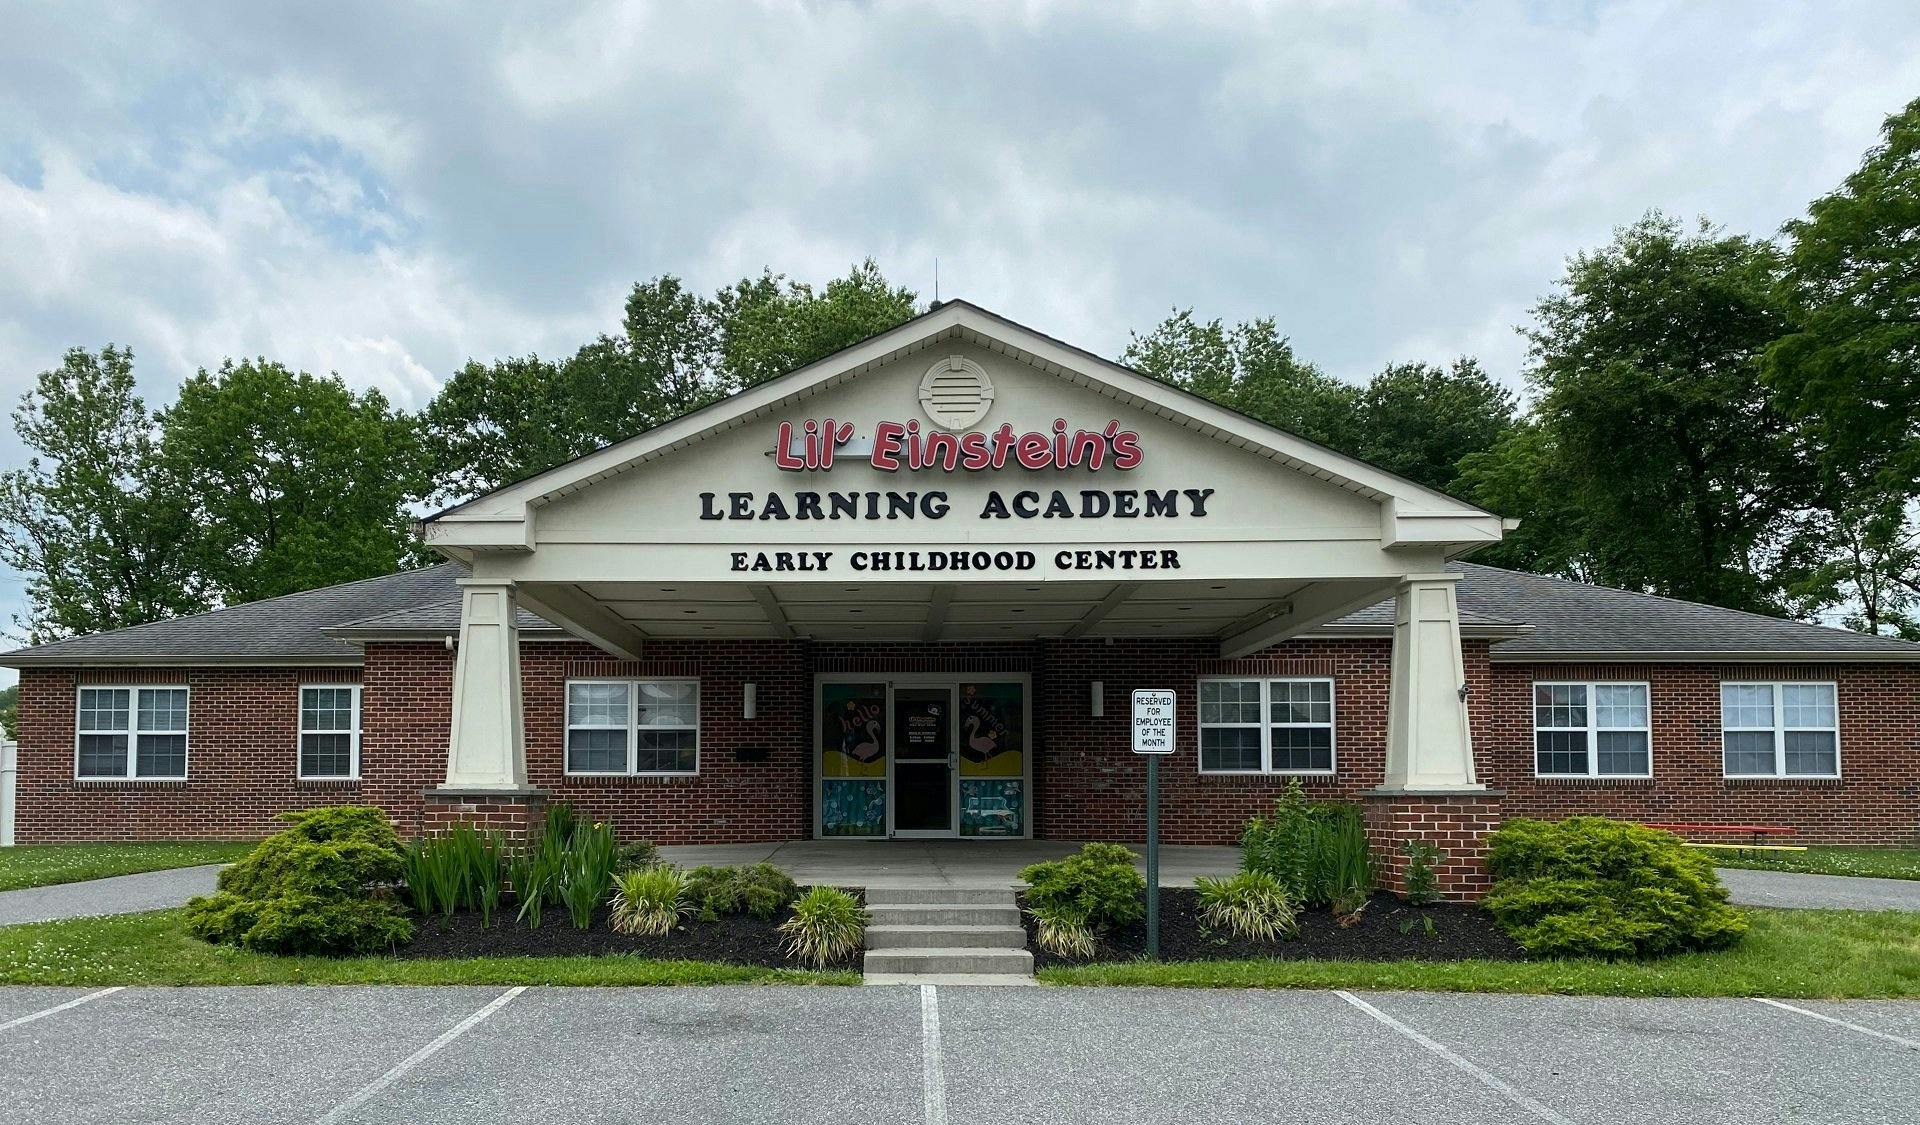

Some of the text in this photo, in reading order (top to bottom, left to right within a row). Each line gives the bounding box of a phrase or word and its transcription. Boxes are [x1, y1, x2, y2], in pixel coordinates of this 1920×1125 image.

[870, 418, 1144, 471] Einstein's
[699, 488, 1215, 520] LEARNING ACADEMY
[730, 550, 1181, 571] EARLY CHILDHOOD CENTER
[1136, 697, 1171, 705] RESERVED
[1146, 707, 1160, 715] FOR
[1136, 718, 1171, 726] EMPLOYEE
[1141, 728, 1165, 736] OF THE
[1142, 738, 1165, 746] MONTH
